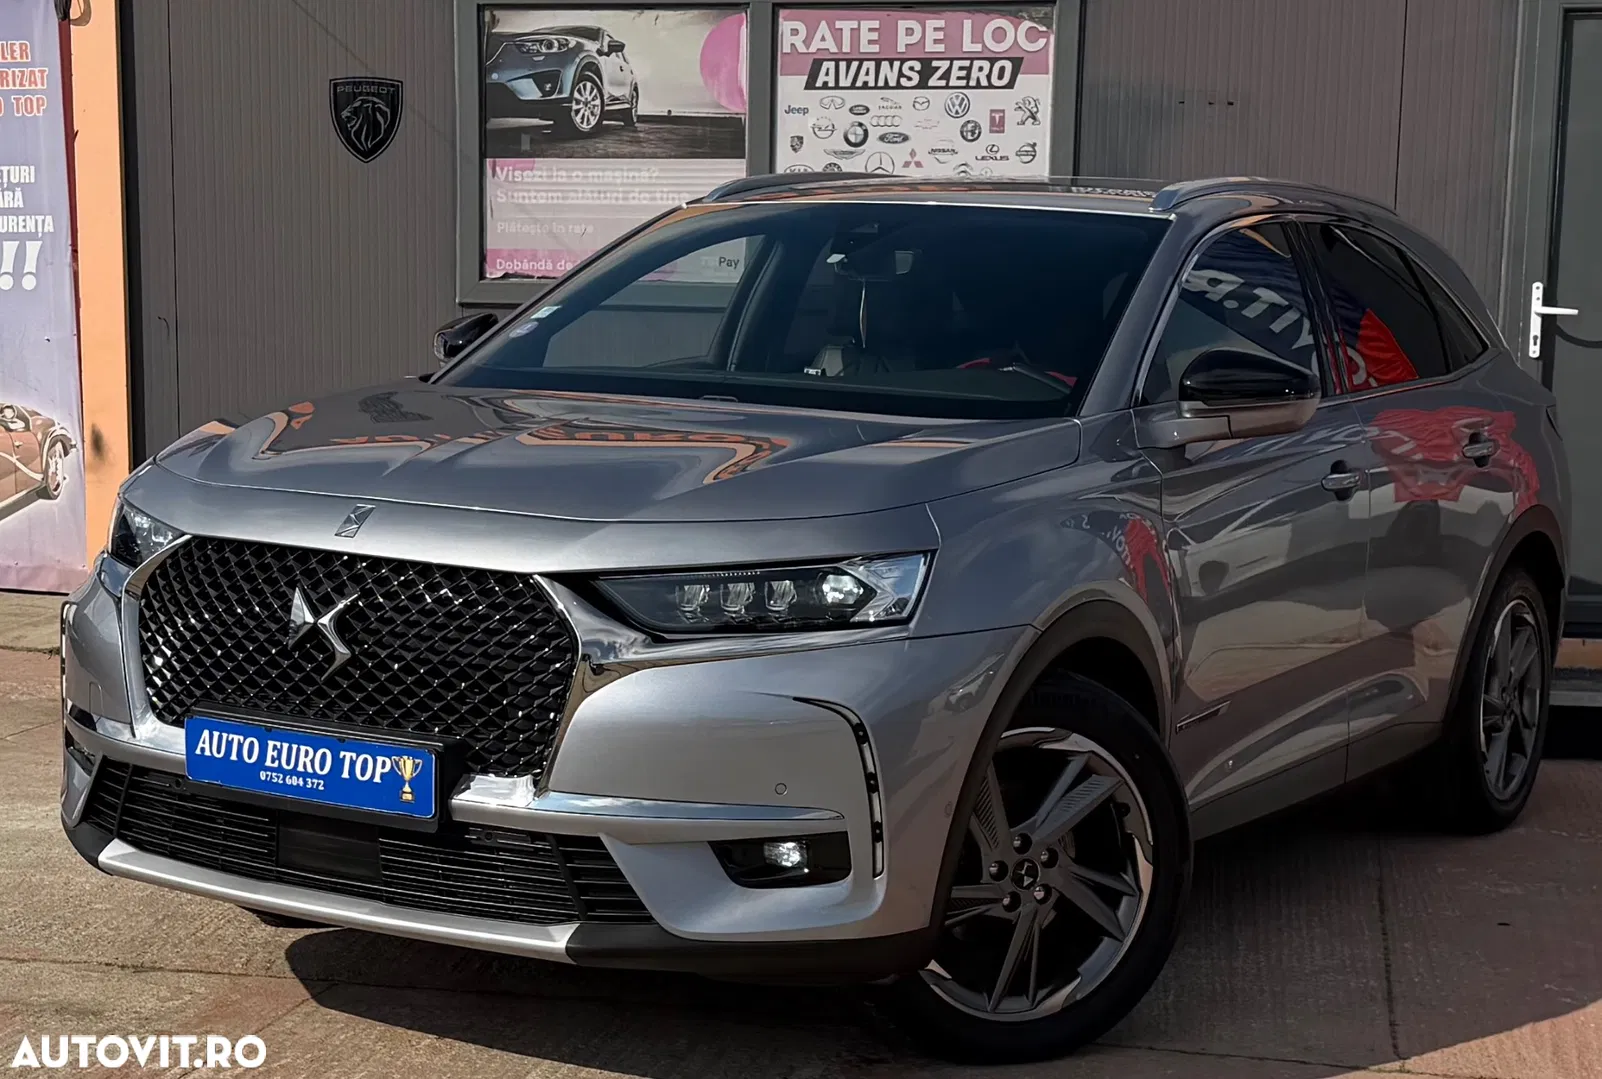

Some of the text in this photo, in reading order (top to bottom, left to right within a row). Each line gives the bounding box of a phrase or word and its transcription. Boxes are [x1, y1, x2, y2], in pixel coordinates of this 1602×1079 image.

[782, 18, 1048, 54] RATE PE LOC
[815, 59, 1013, 88] AVANS ZERO
[337, 85, 396, 94] PEUGEOT
[11, 95, 47, 117] TOP
[784, 104, 809, 116] Jeep
[0, 165, 36, 188] ȚURI
[719, 256, 740, 270] Pay
[195, 729, 392, 784] AUTO EURO TOP
[259, 770, 284, 784] 0752
[305, 777, 325, 791] 372
